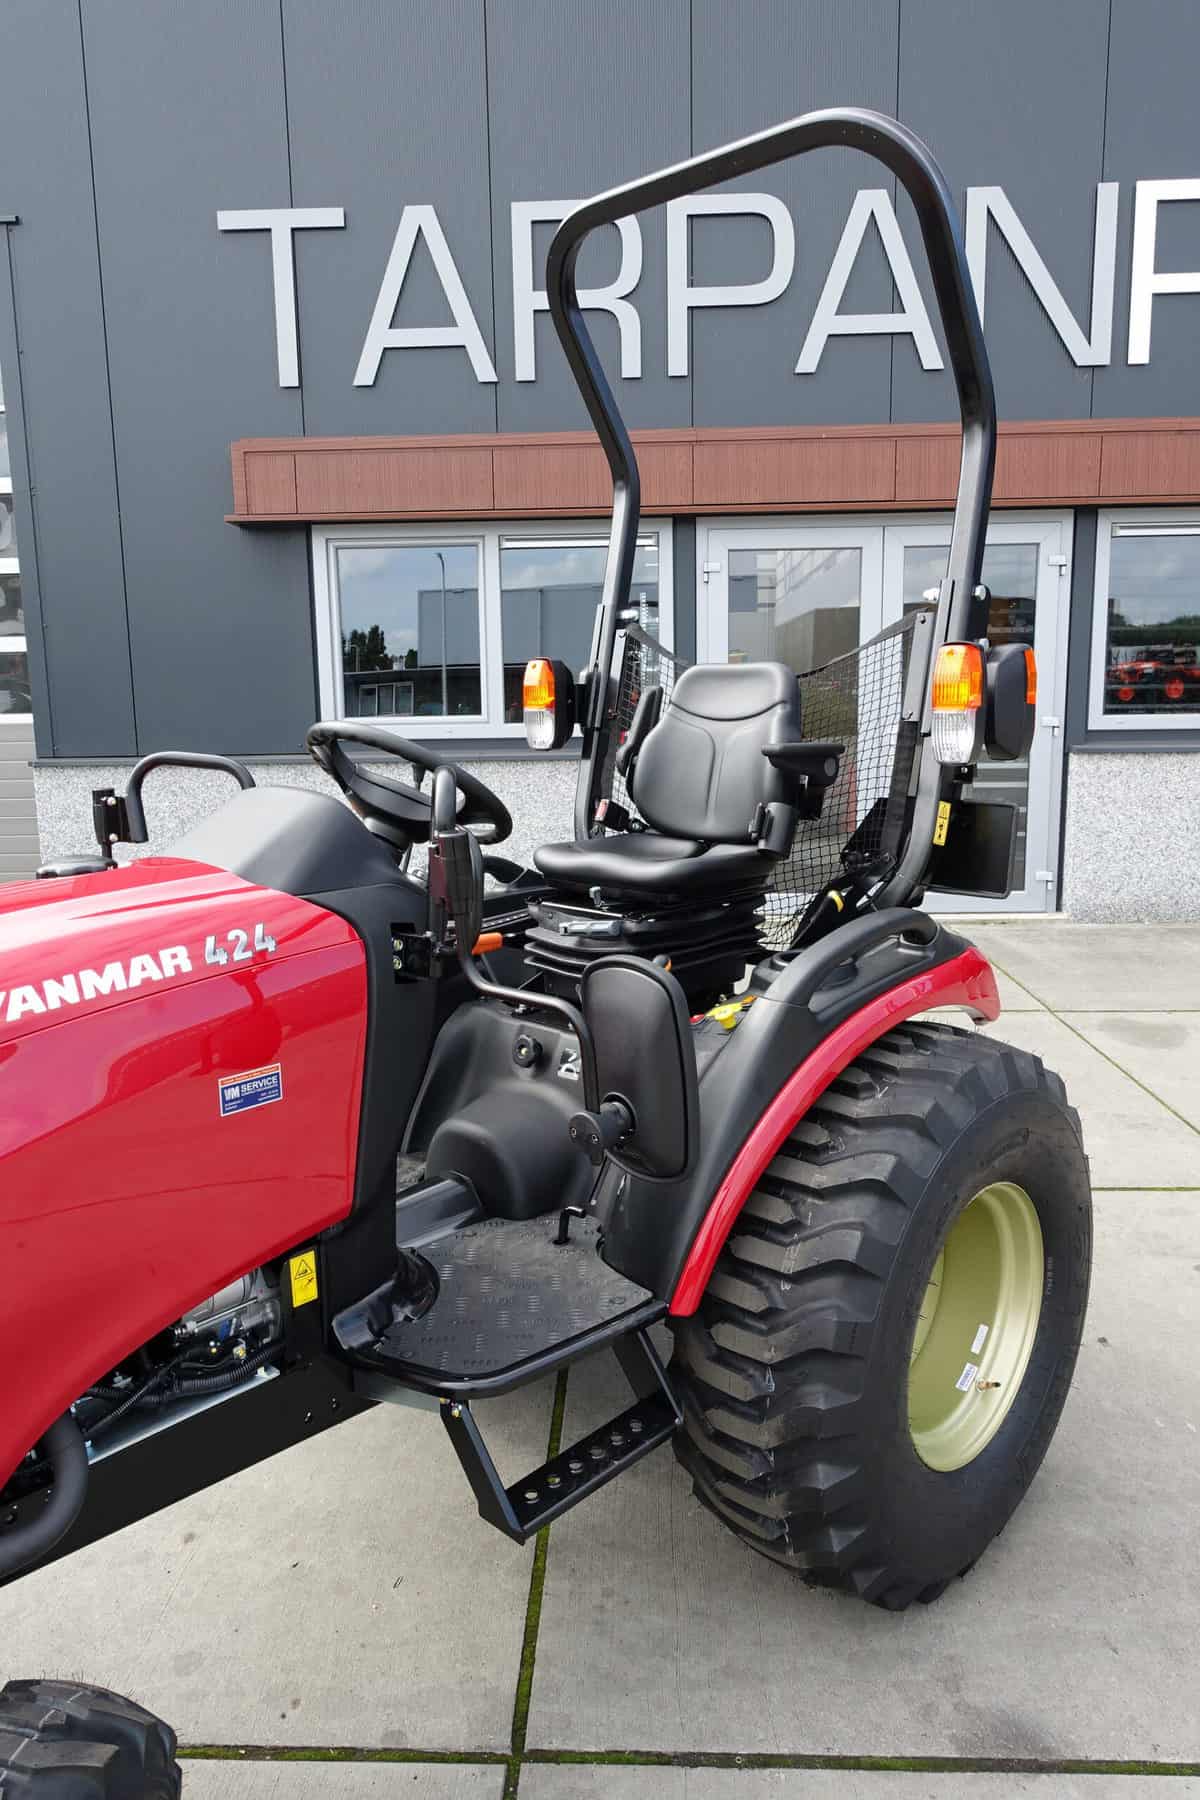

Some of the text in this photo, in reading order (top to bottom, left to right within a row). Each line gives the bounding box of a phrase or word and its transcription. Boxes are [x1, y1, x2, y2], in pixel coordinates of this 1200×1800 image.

[0, 922, 277, 1022] ANMAR 424
[241, 1075, 278, 1093] SERVICE
